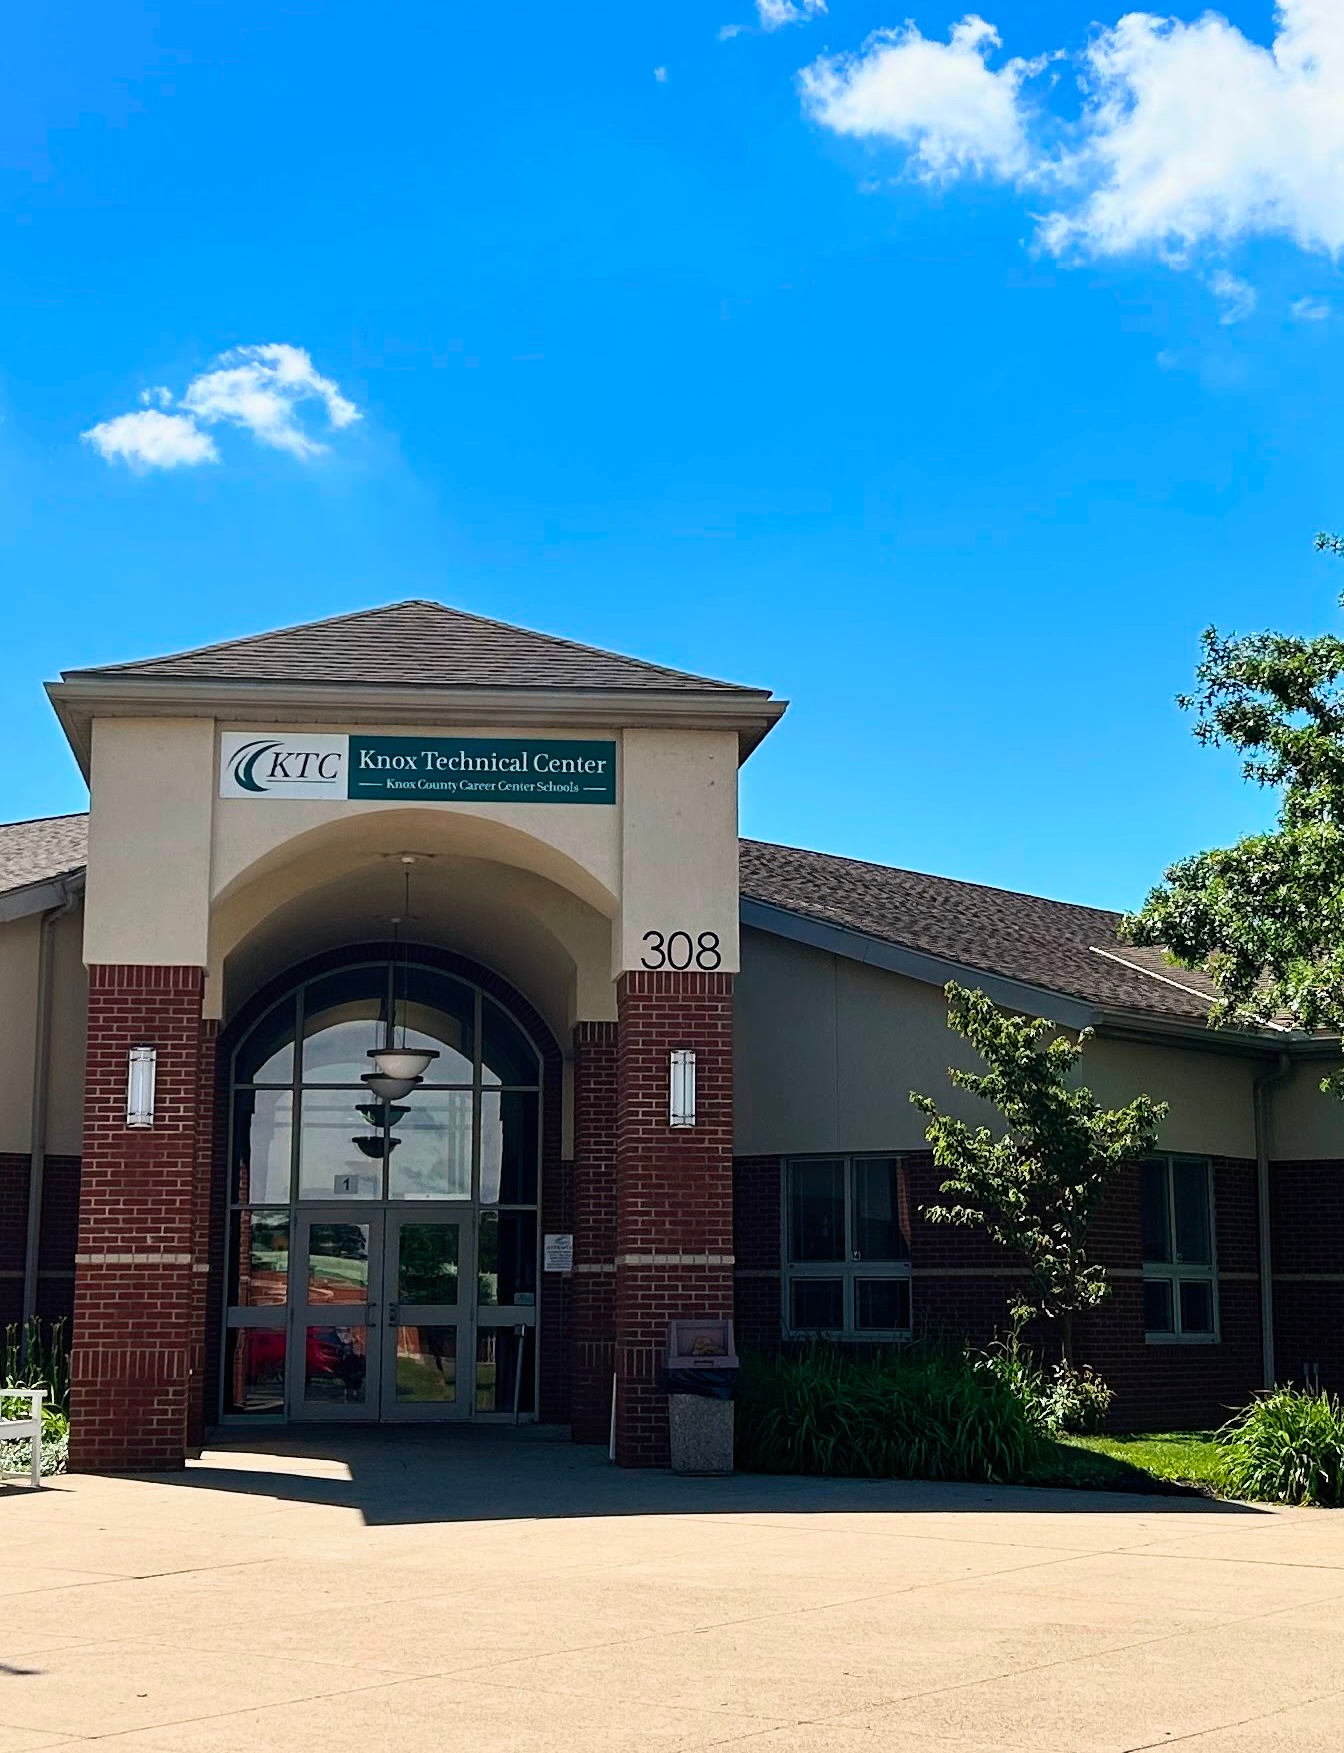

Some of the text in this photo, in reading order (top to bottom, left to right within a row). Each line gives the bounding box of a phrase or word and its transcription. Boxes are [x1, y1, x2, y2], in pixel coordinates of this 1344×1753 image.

[266, 751, 342, 779] KTC
[359, 749, 607, 774] Knox Technical Center
[386, 778, 579, 794] Knox County Career Center Schools
[640, 930, 721, 970] 308
[342, 1177, 349, 1190] 1
